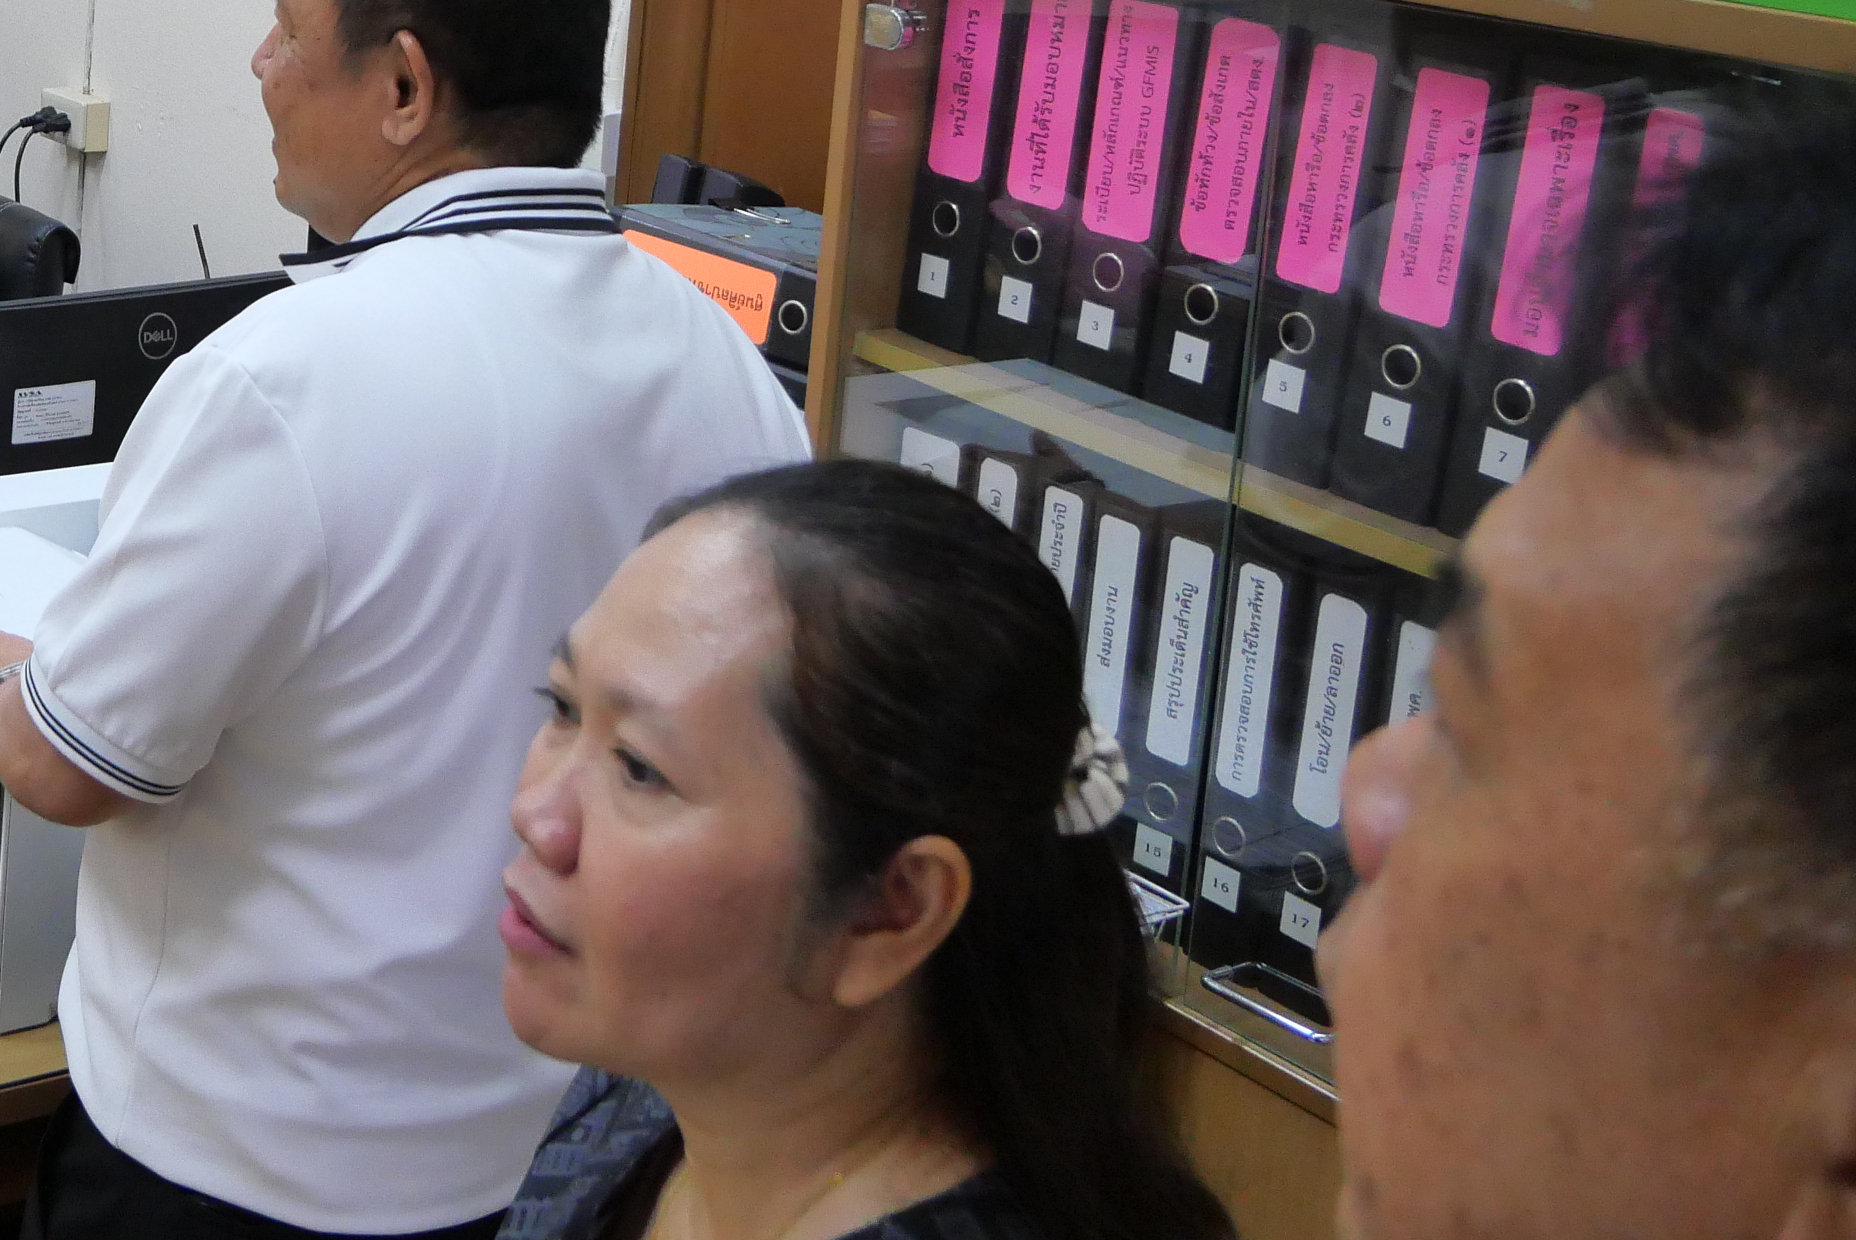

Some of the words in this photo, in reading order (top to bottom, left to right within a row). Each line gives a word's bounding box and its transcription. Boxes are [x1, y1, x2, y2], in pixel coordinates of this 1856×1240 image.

[949, 8, 980, 139] หนังสือสั่งการ
[1141, 43, 1160, 100] GFMIS
[929, 269, 936, 281] 1
[1010, 293, 1019, 305] 2
[144, 329, 173, 343] DELL
[1184, 352, 1193, 364] 4
[1382, 414, 1391, 427] 6
[1498, 451, 1508, 463] 7
[1096, 585, 1119, 669] ส่งมอบงาน
[1164, 581, 1200, 721] สรุปประเด็นสำคัญ
[1229, 576, 1266, 782] การตรวจสอบการใช้โทรศัพท์
[1308, 641, 1346, 775] โอน/ย้าย/ลาออก
[1145, 841, 1161, 856] 15
[1213, 877, 1229, 892] 16
[1291, 914, 1310, 929] 17
